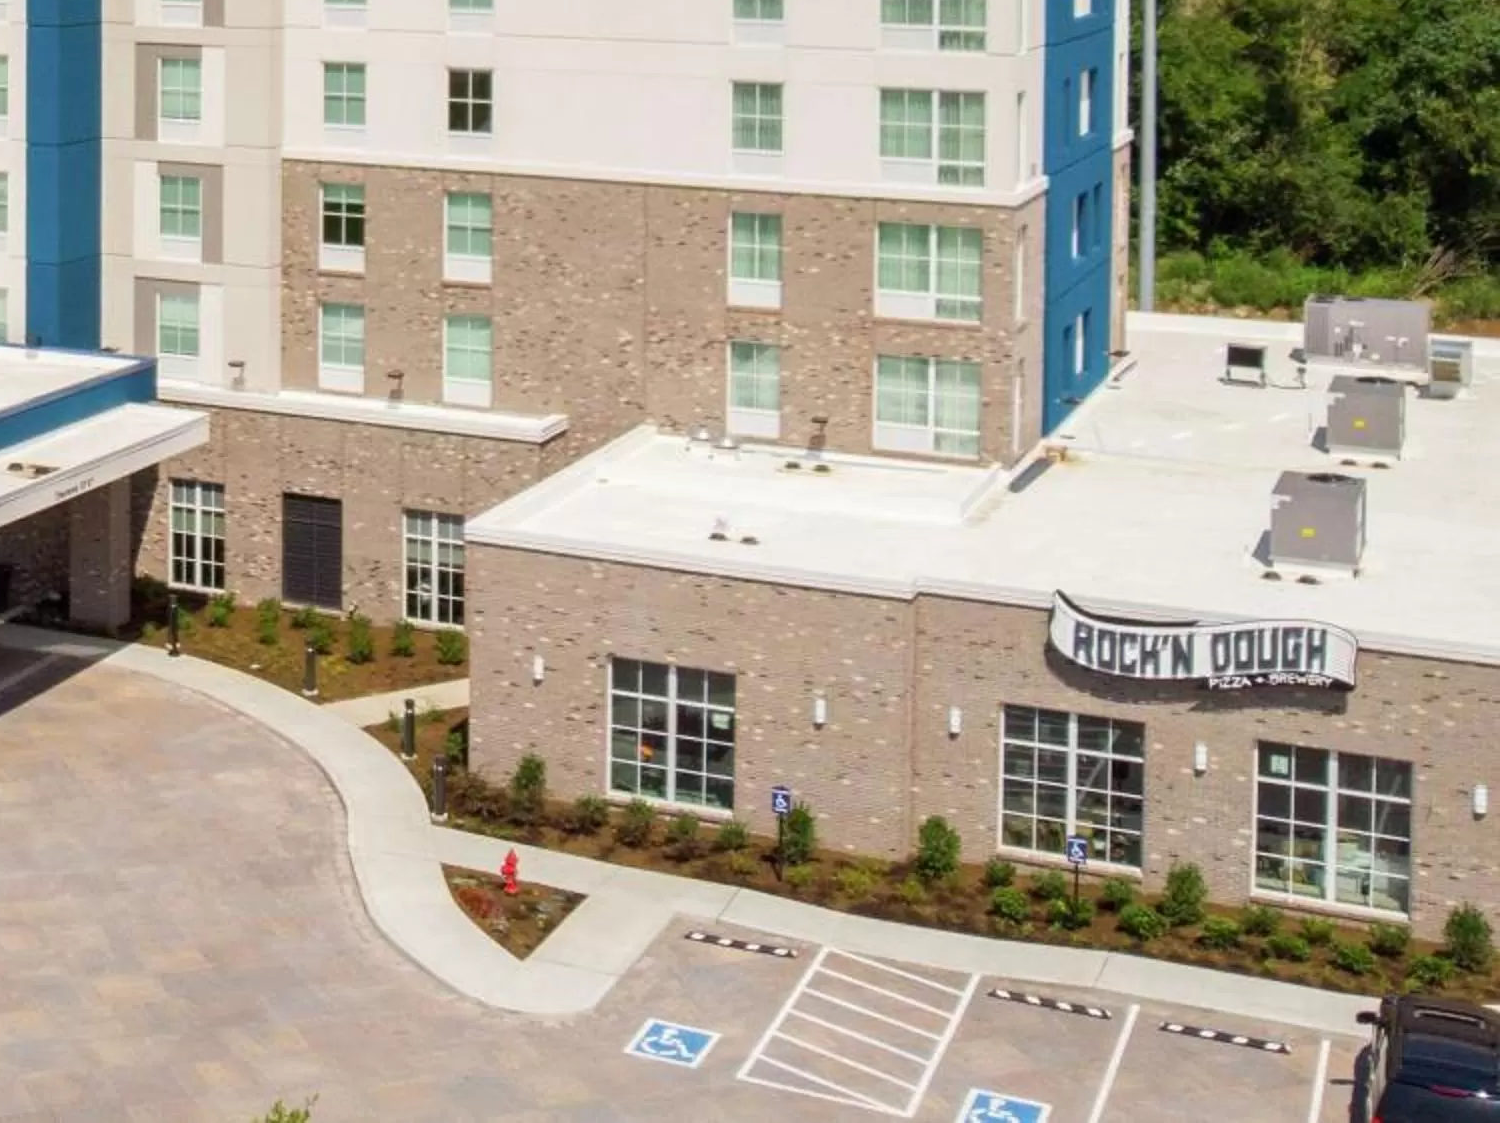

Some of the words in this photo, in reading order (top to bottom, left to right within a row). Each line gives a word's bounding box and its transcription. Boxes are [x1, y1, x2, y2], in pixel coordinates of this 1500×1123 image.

[1073, 620, 1195, 675] ROCK'N
[1211, 627, 1328, 673] DOUGH
[1209, 676, 1253, 691] PIZZA
